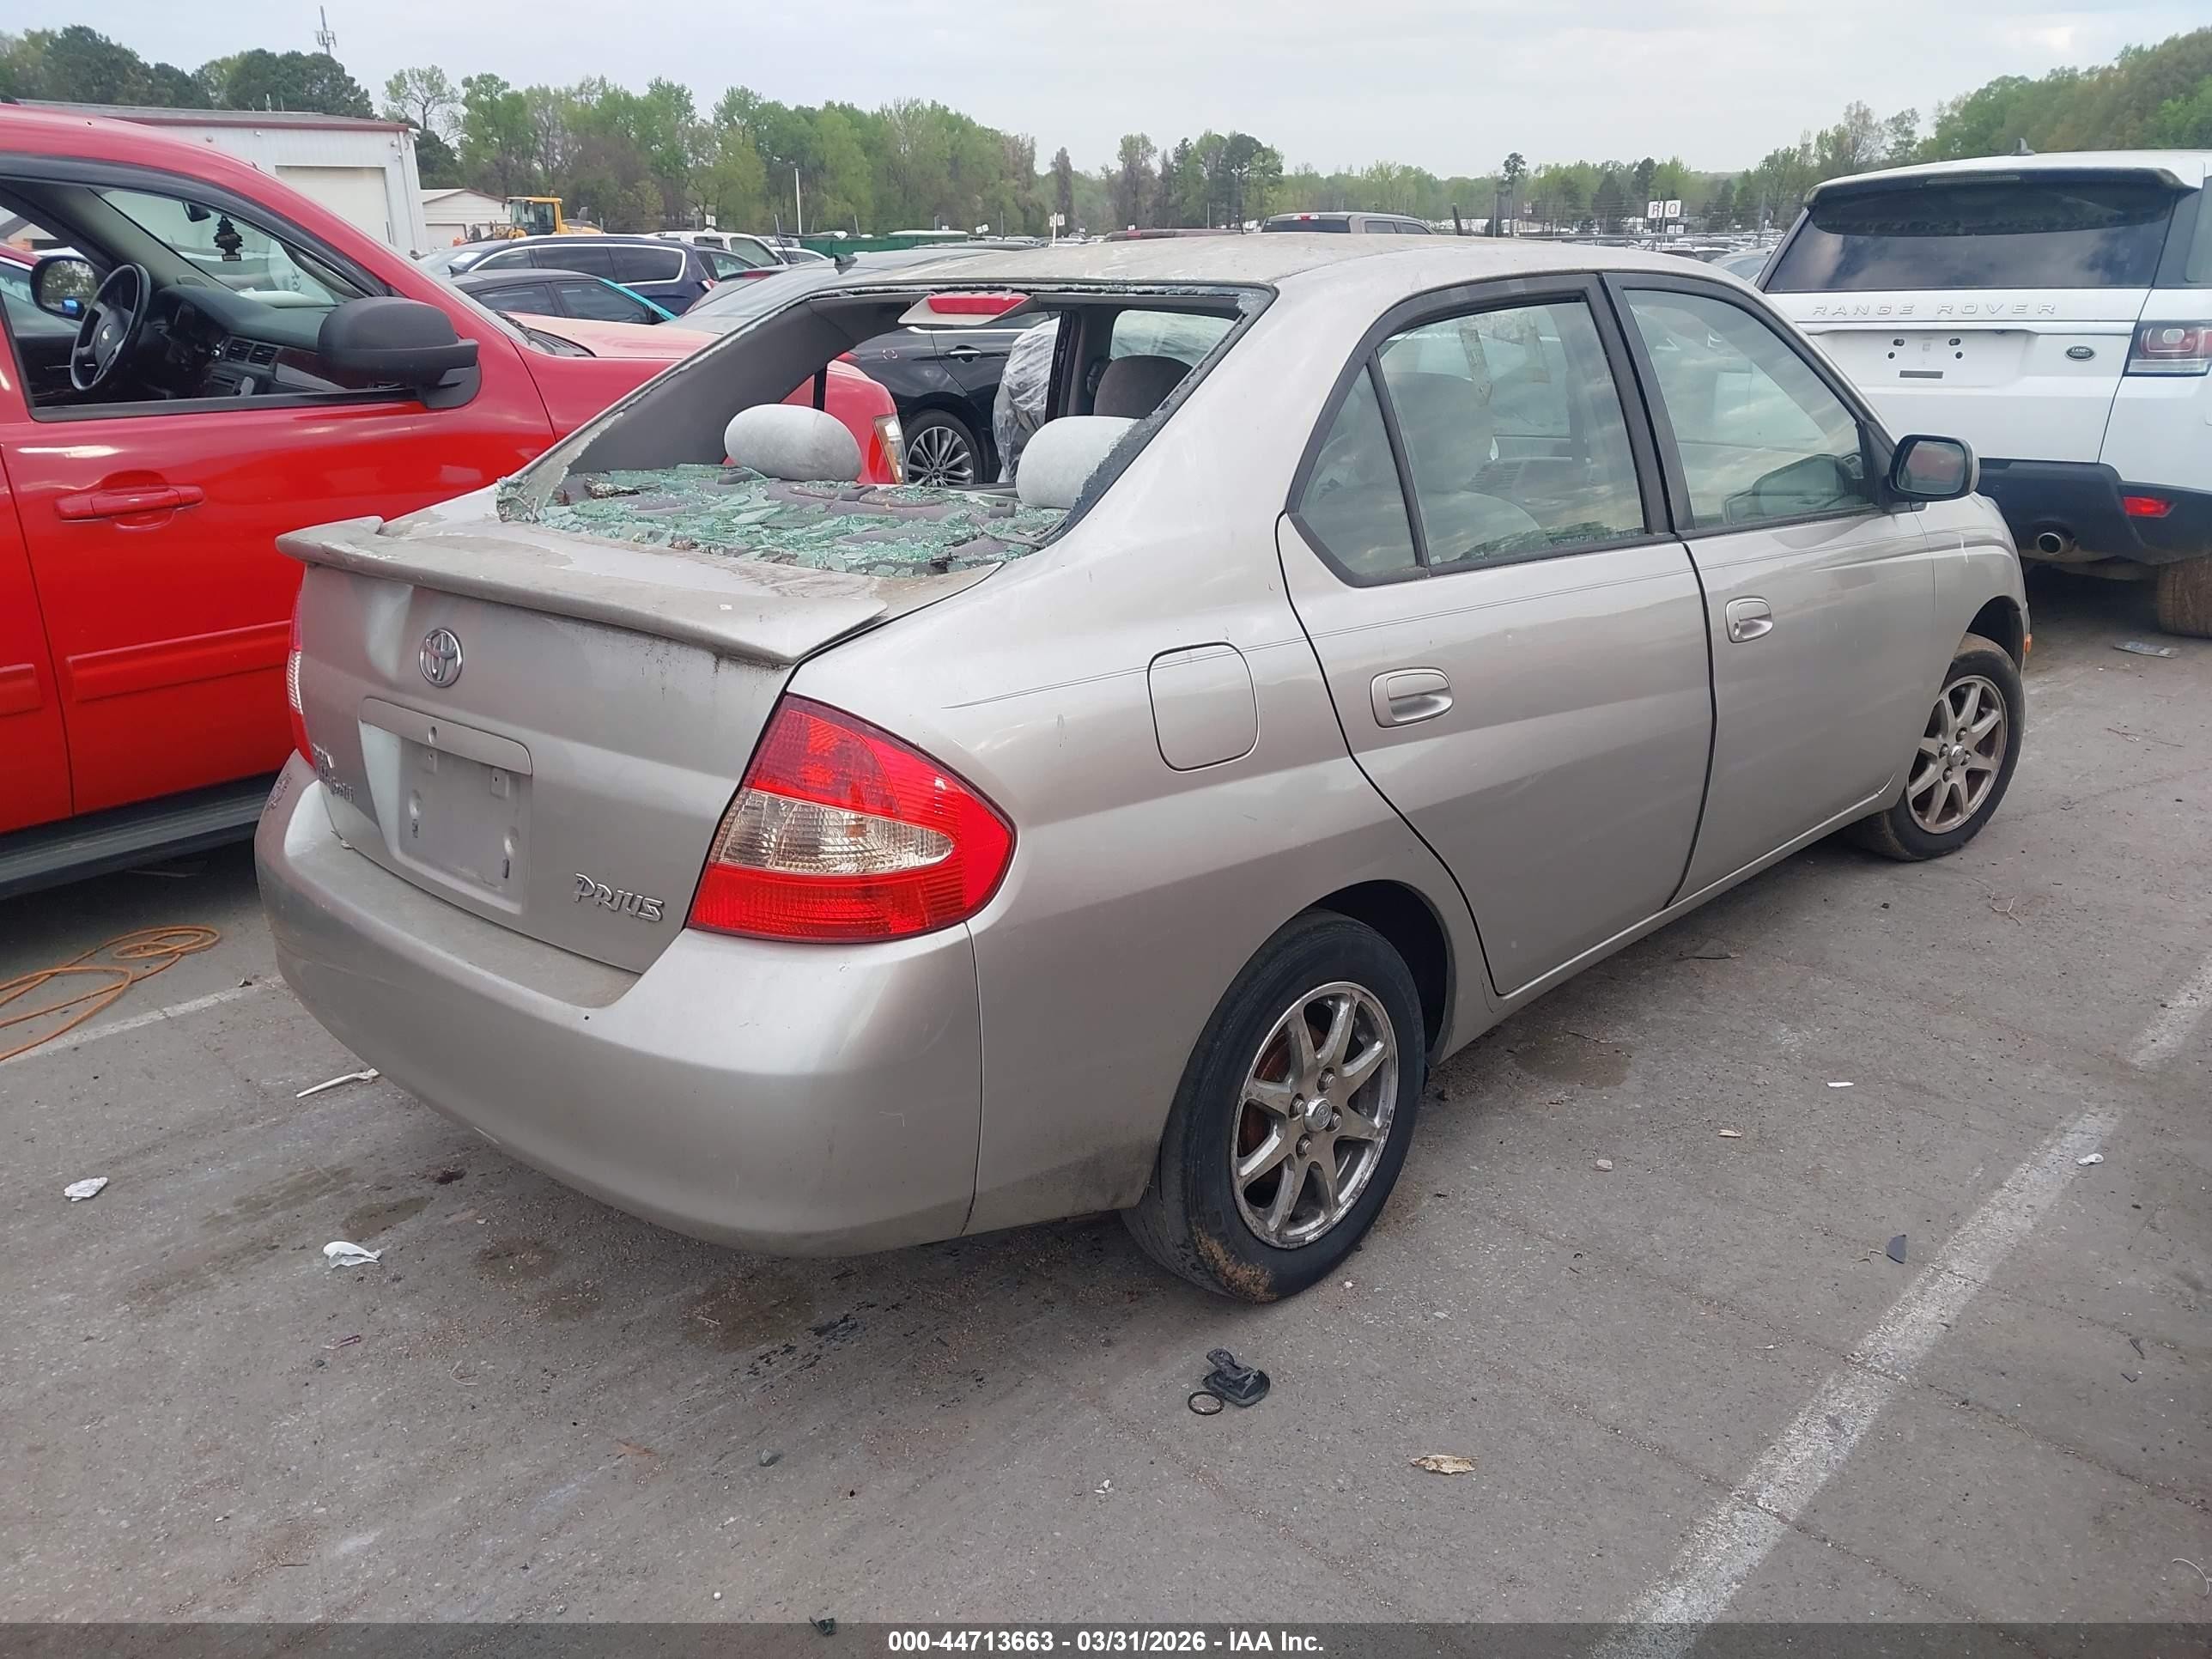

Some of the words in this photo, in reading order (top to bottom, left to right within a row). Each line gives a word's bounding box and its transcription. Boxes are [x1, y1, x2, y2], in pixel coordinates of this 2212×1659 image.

[1812, 303, 1916, 316] RANGE
[1936, 302, 2057, 315] ROVER
[574, 872, 665, 921] PRIUS
